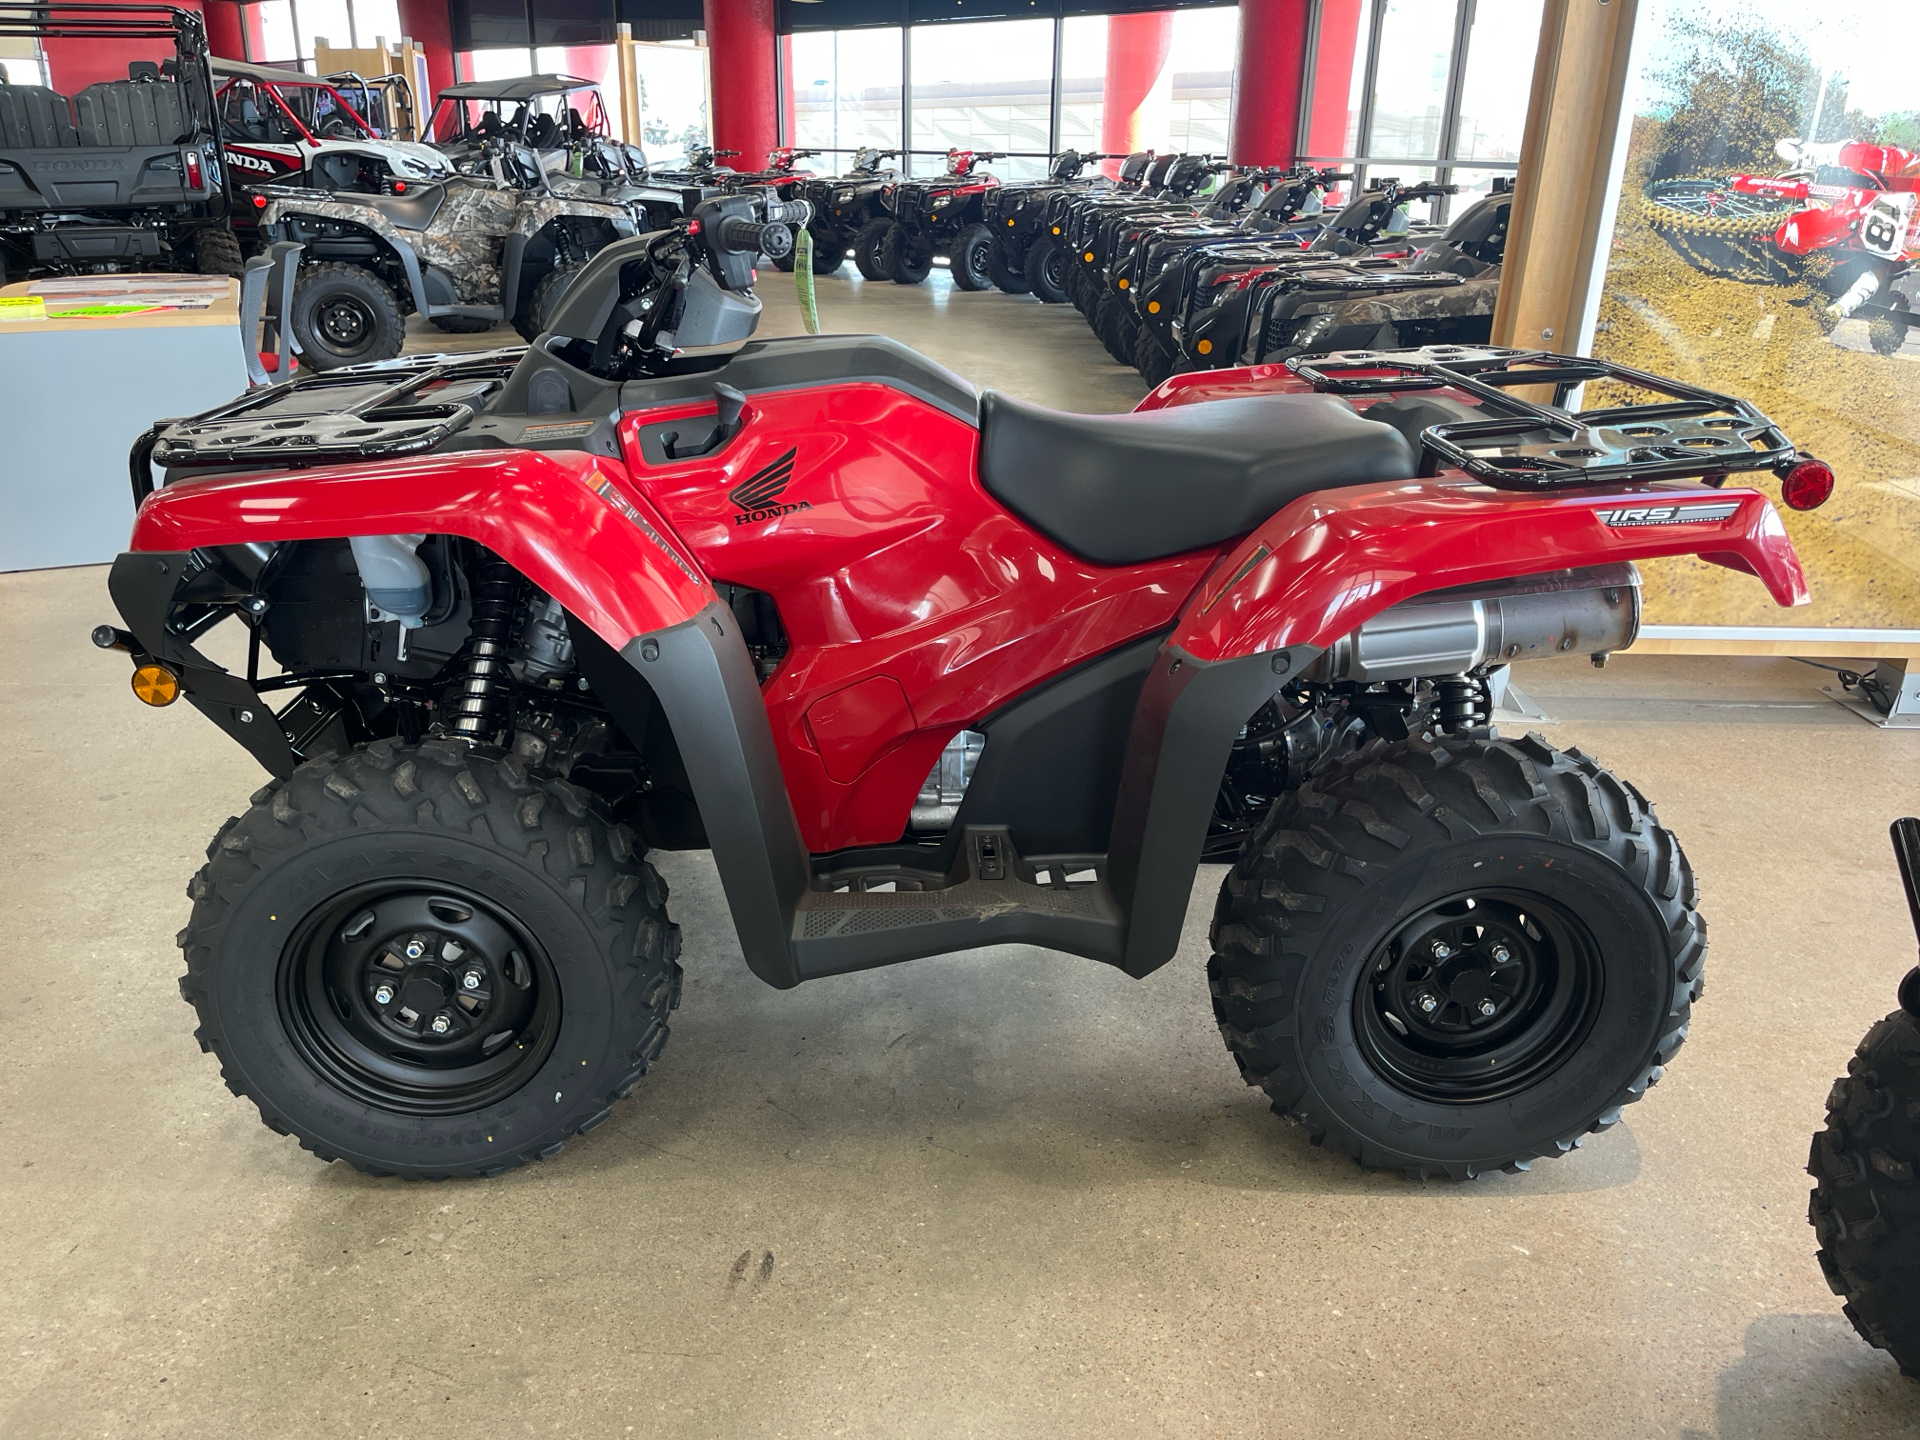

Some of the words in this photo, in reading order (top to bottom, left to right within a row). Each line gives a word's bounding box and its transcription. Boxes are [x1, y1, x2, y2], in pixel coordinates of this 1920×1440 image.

[31, 159, 133, 172] HONDA
[223, 151, 277, 174] NDA
[1865, 199, 1901, 250] 18
[734, 501, 814, 526] HONDA
[1610, 507, 1675, 521] IRS
[291, 849, 531, 901] MAXXIS
[1323, 943, 1354, 1006] M978
[1318, 1013, 1475, 1143] MAXXIS
